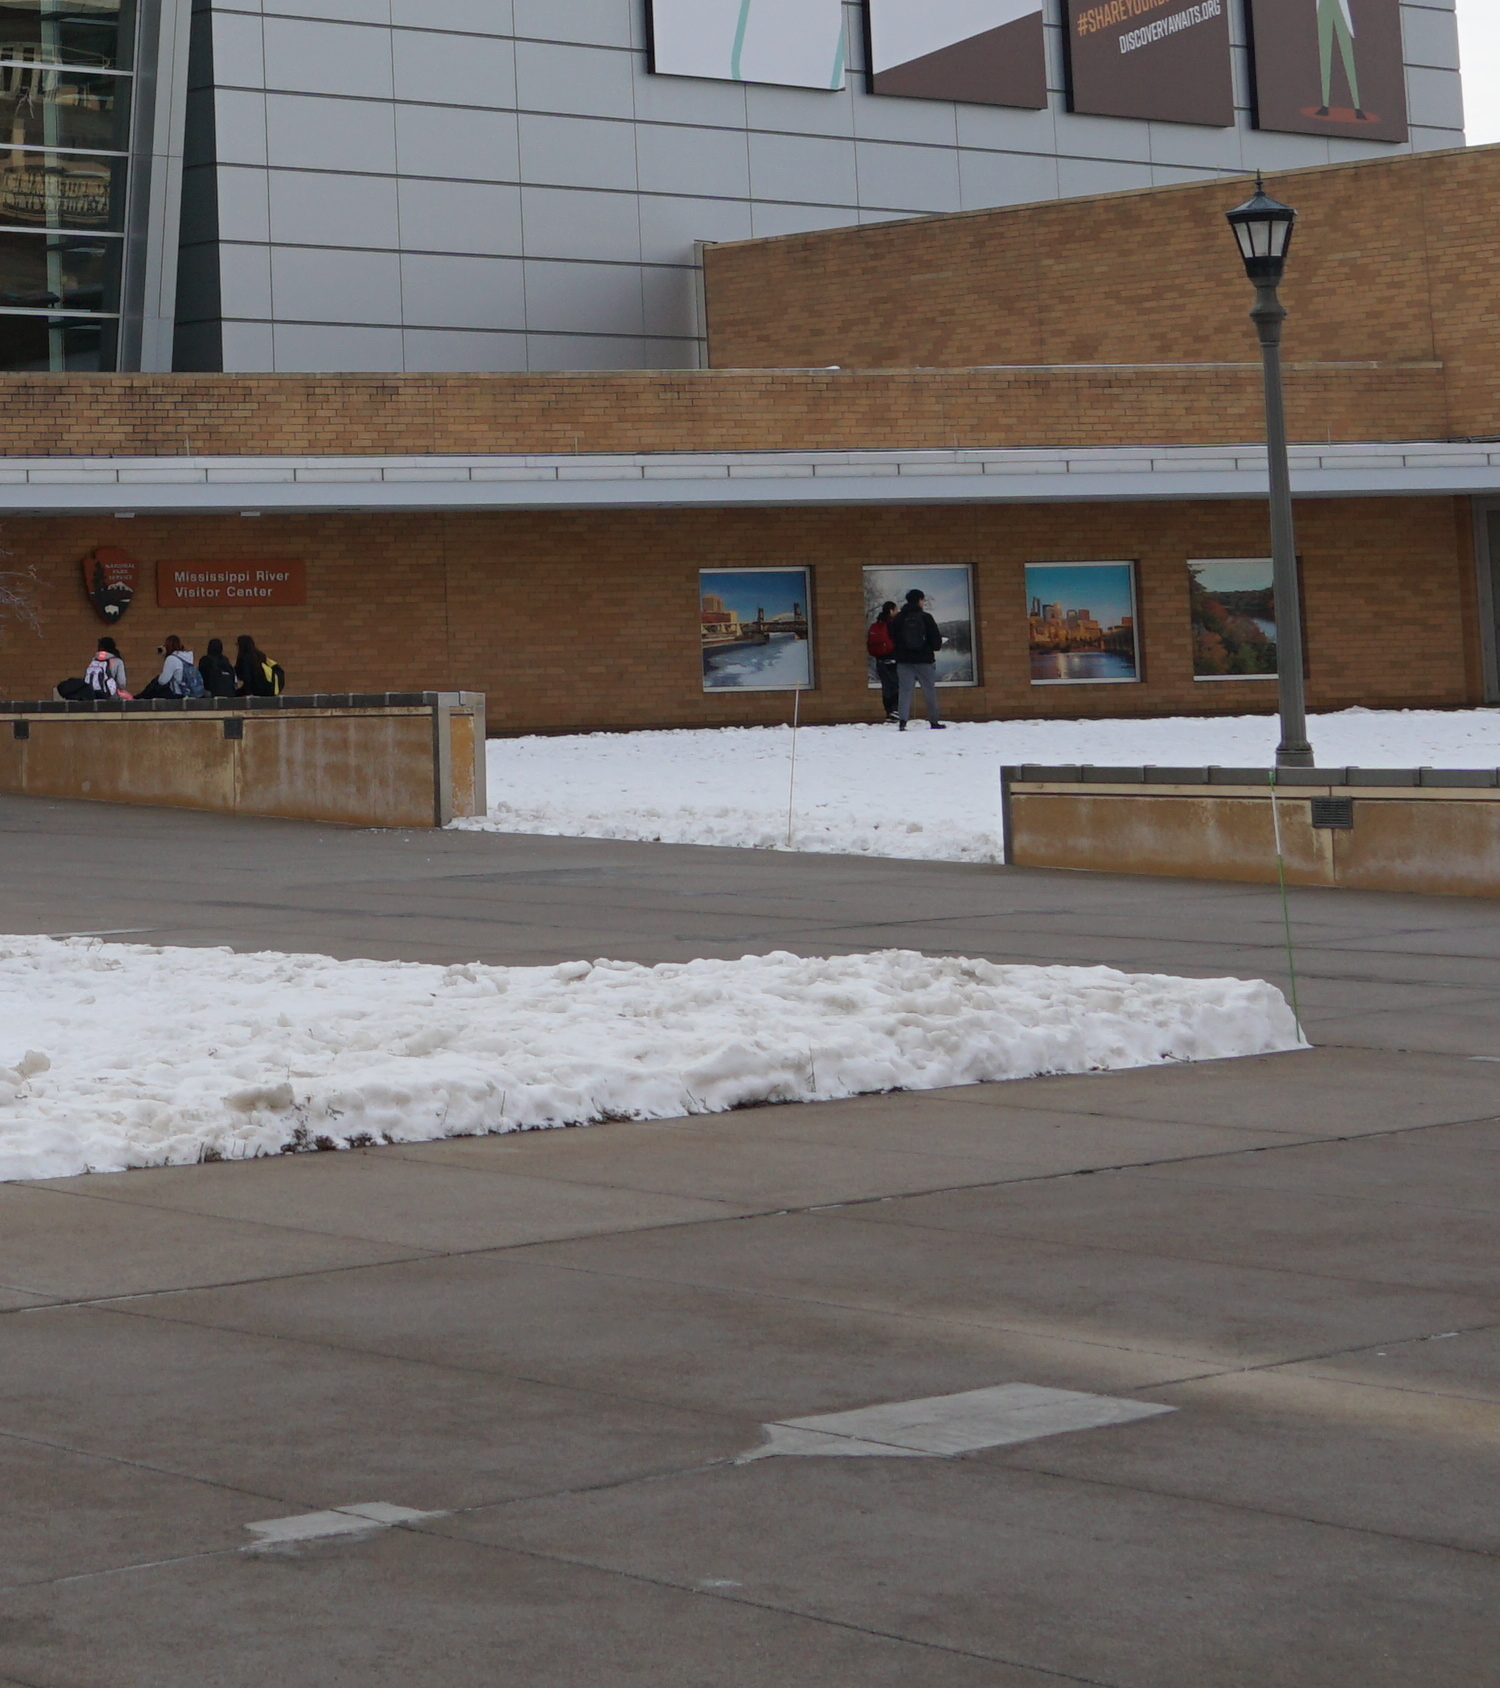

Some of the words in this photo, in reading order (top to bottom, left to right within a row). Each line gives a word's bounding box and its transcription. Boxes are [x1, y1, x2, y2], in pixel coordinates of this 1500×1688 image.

[174, 570, 250, 584] Mississippi
[256, 570, 289, 582] River
[175, 586, 220, 598] Visitor
[226, 586, 273, 598] Center
